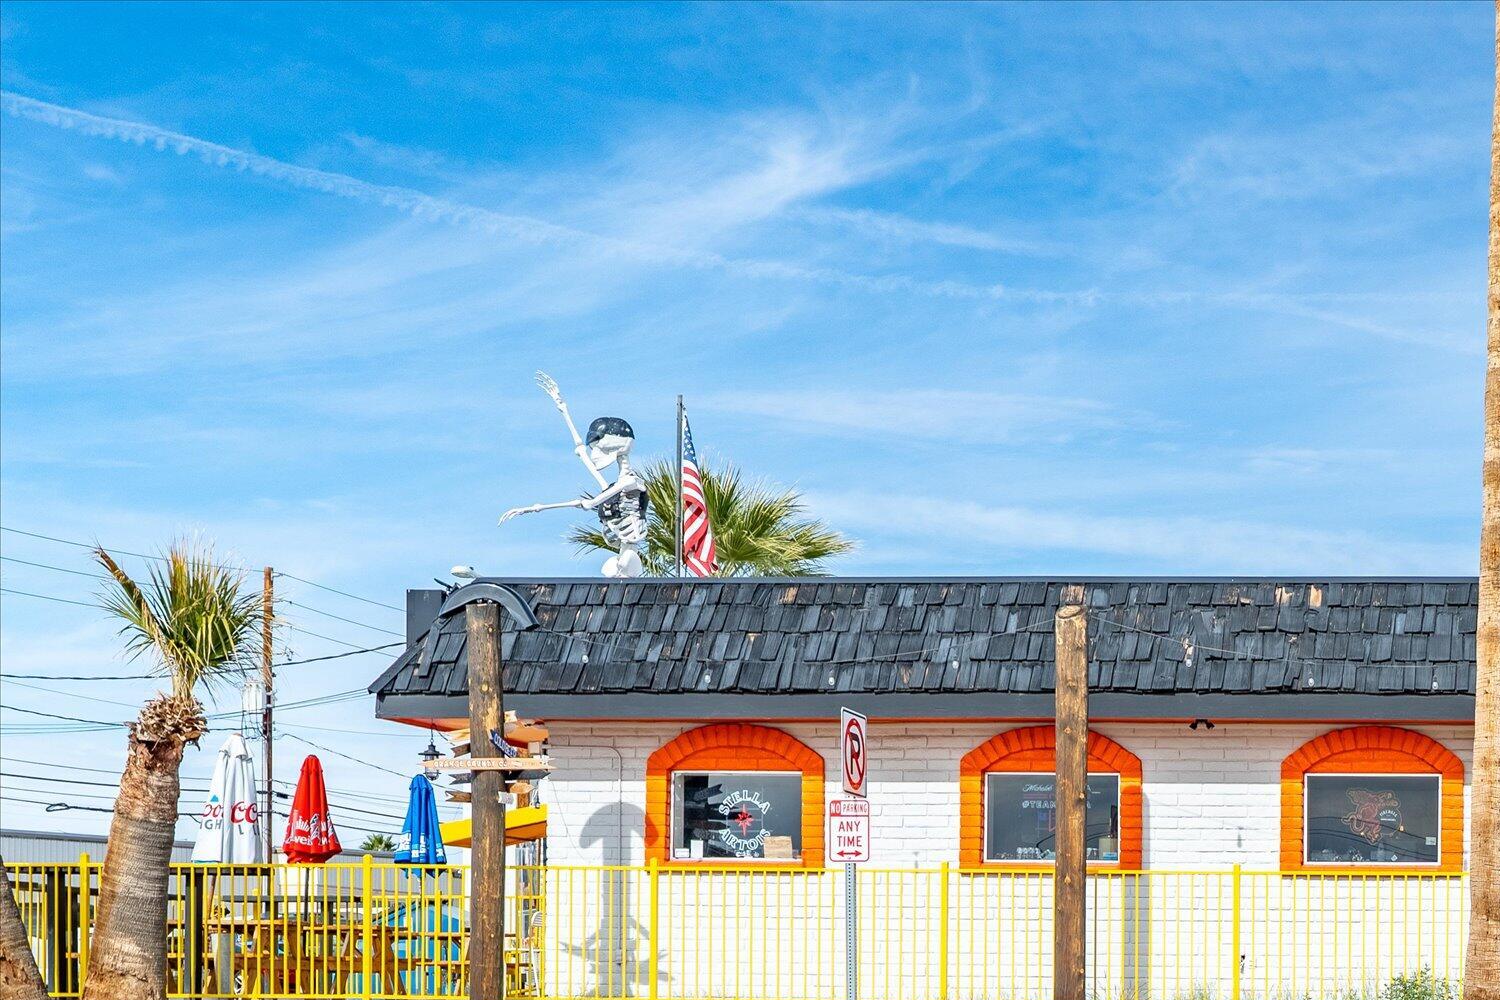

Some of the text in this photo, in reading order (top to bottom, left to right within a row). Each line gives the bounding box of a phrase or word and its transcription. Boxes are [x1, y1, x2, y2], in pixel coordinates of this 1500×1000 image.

[718, 790, 771, 816] STELLA
[830, 802, 868, 813] NO PARKING
[838, 821, 861, 832] ANY
[718, 828, 771, 851] ARTOIS
[837, 835, 863, 848] TIME
